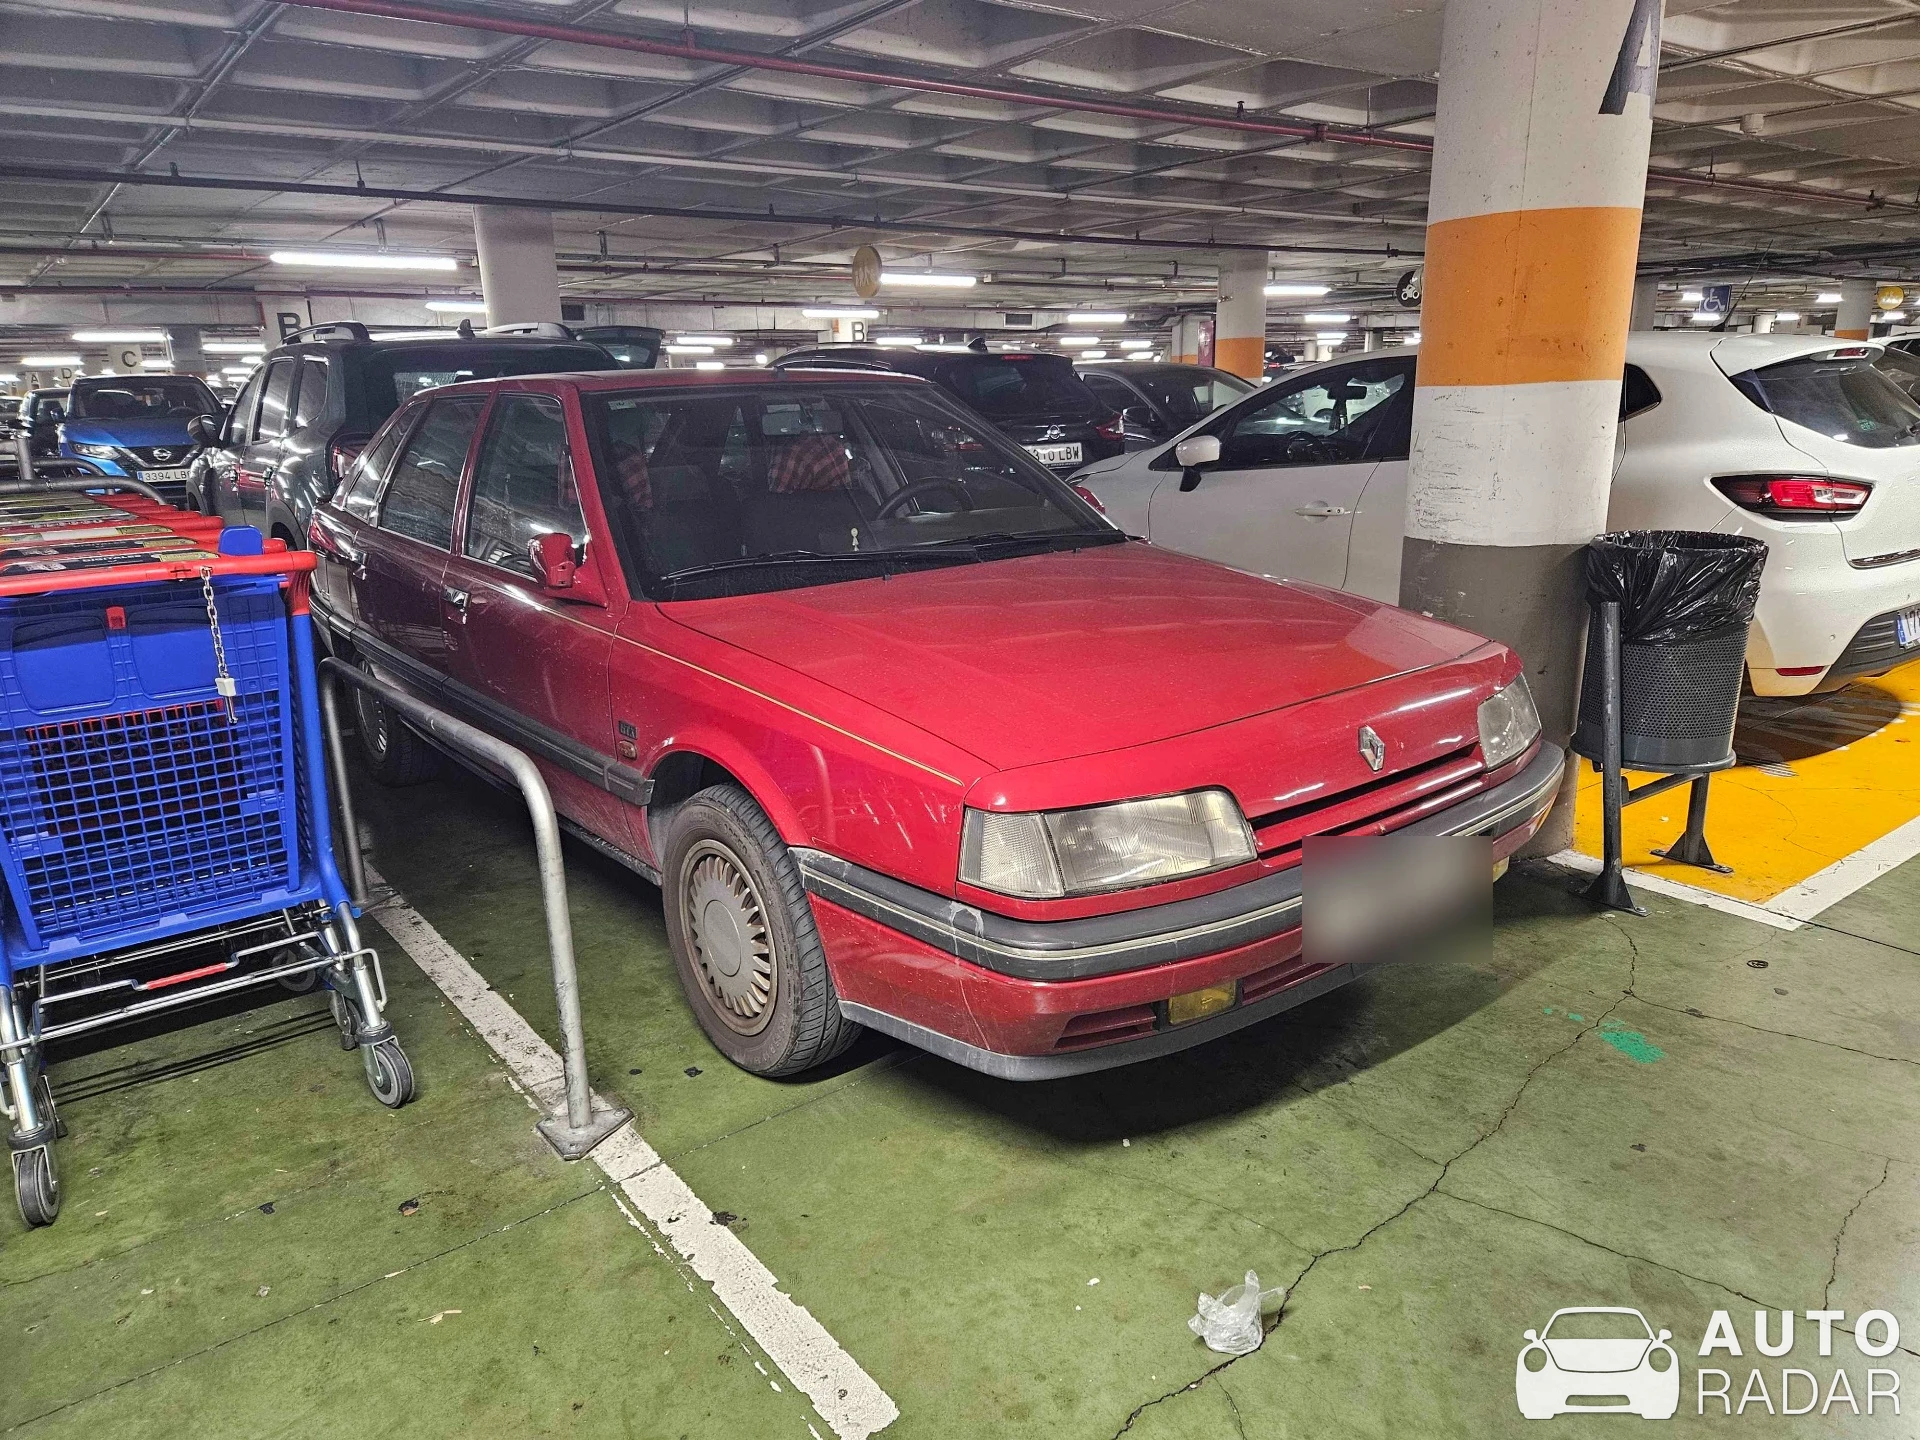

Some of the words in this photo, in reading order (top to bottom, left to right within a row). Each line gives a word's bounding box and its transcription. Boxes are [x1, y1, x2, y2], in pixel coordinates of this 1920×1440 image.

[276, 312, 302, 344] B
[851, 321, 865, 342] B
[121, 350, 137, 367] C
[61, 367, 72, 379] D
[1058, 446, 1080, 461] LBW
[145, 471, 171, 481] 3394
